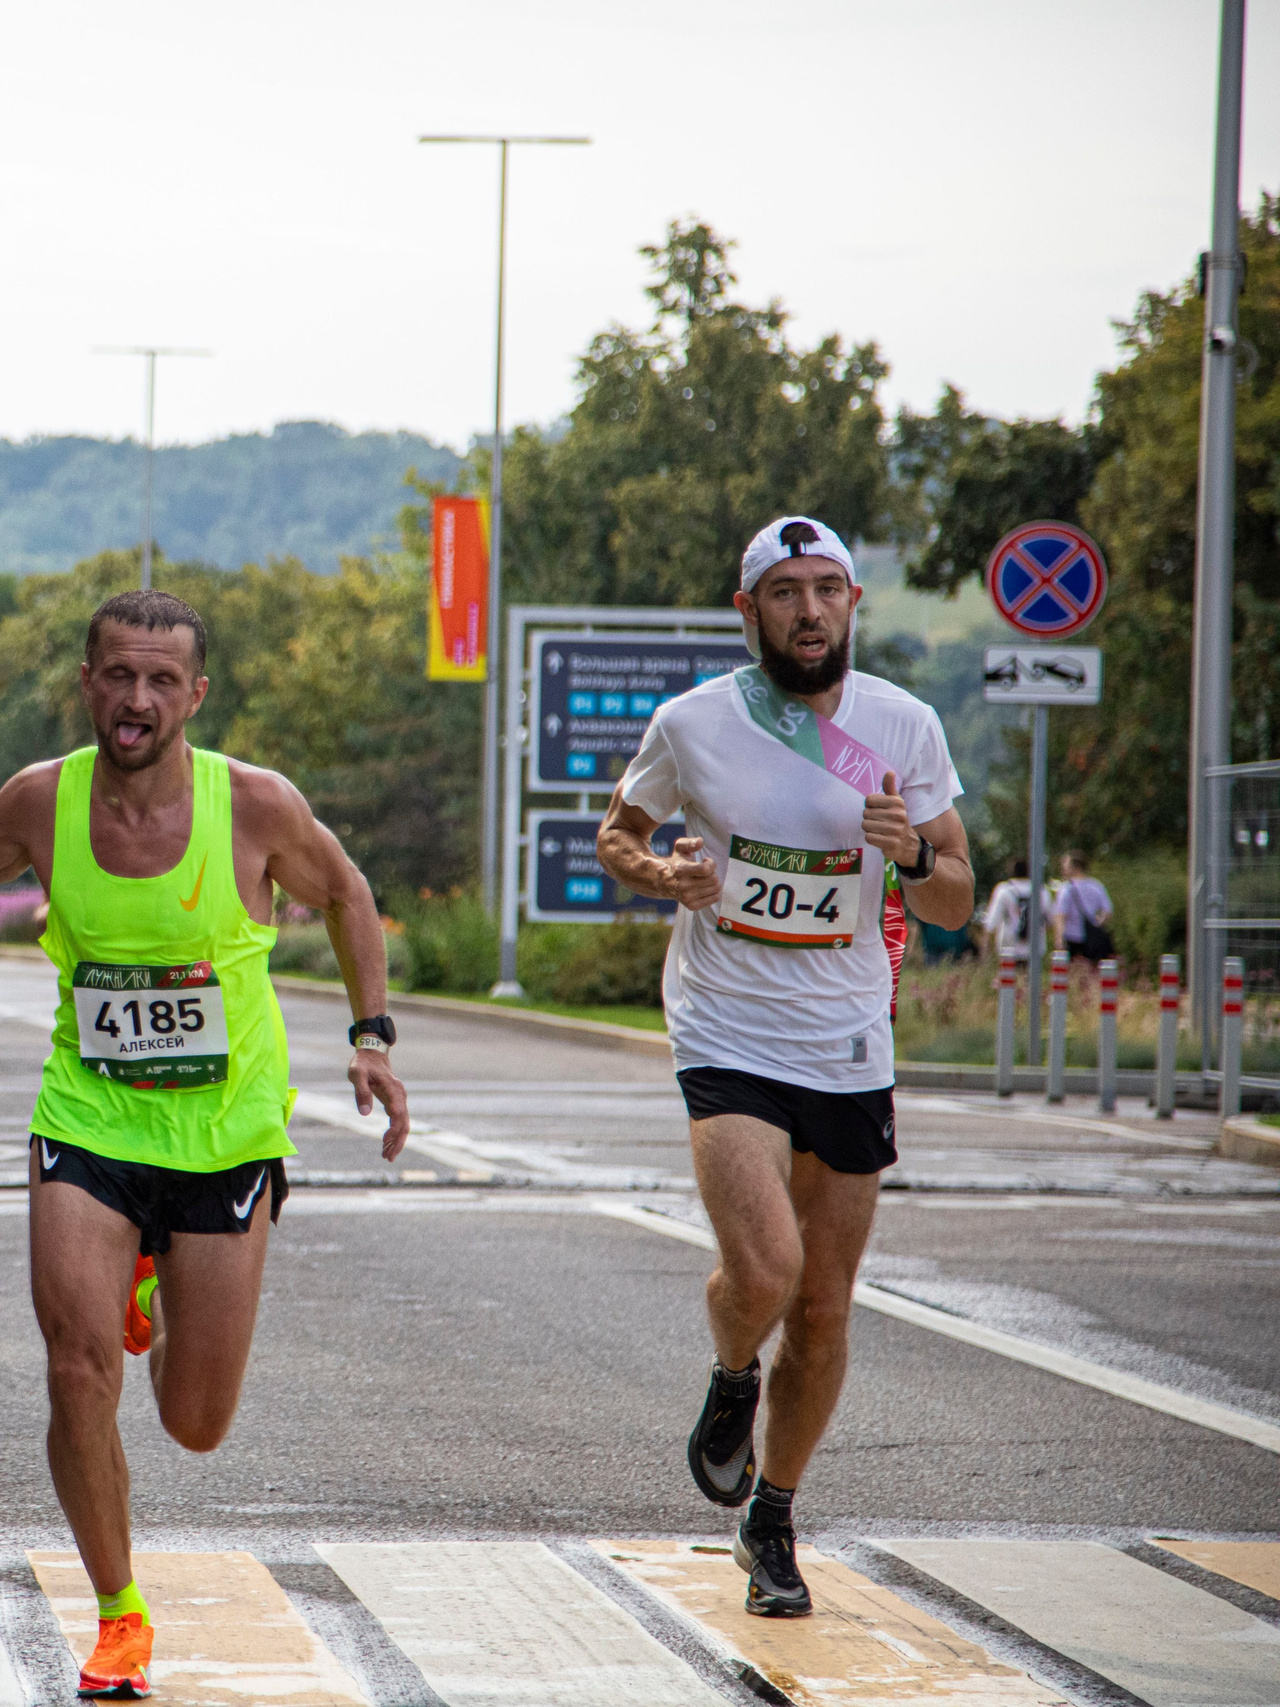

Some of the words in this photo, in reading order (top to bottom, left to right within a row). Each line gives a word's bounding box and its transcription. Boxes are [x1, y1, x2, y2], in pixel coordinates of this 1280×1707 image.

[741, 877, 839, 923] 20-4
[94, 998, 205, 1038] 4185
[119, 1035, 185, 1053] АЛЕКСЕЙ
